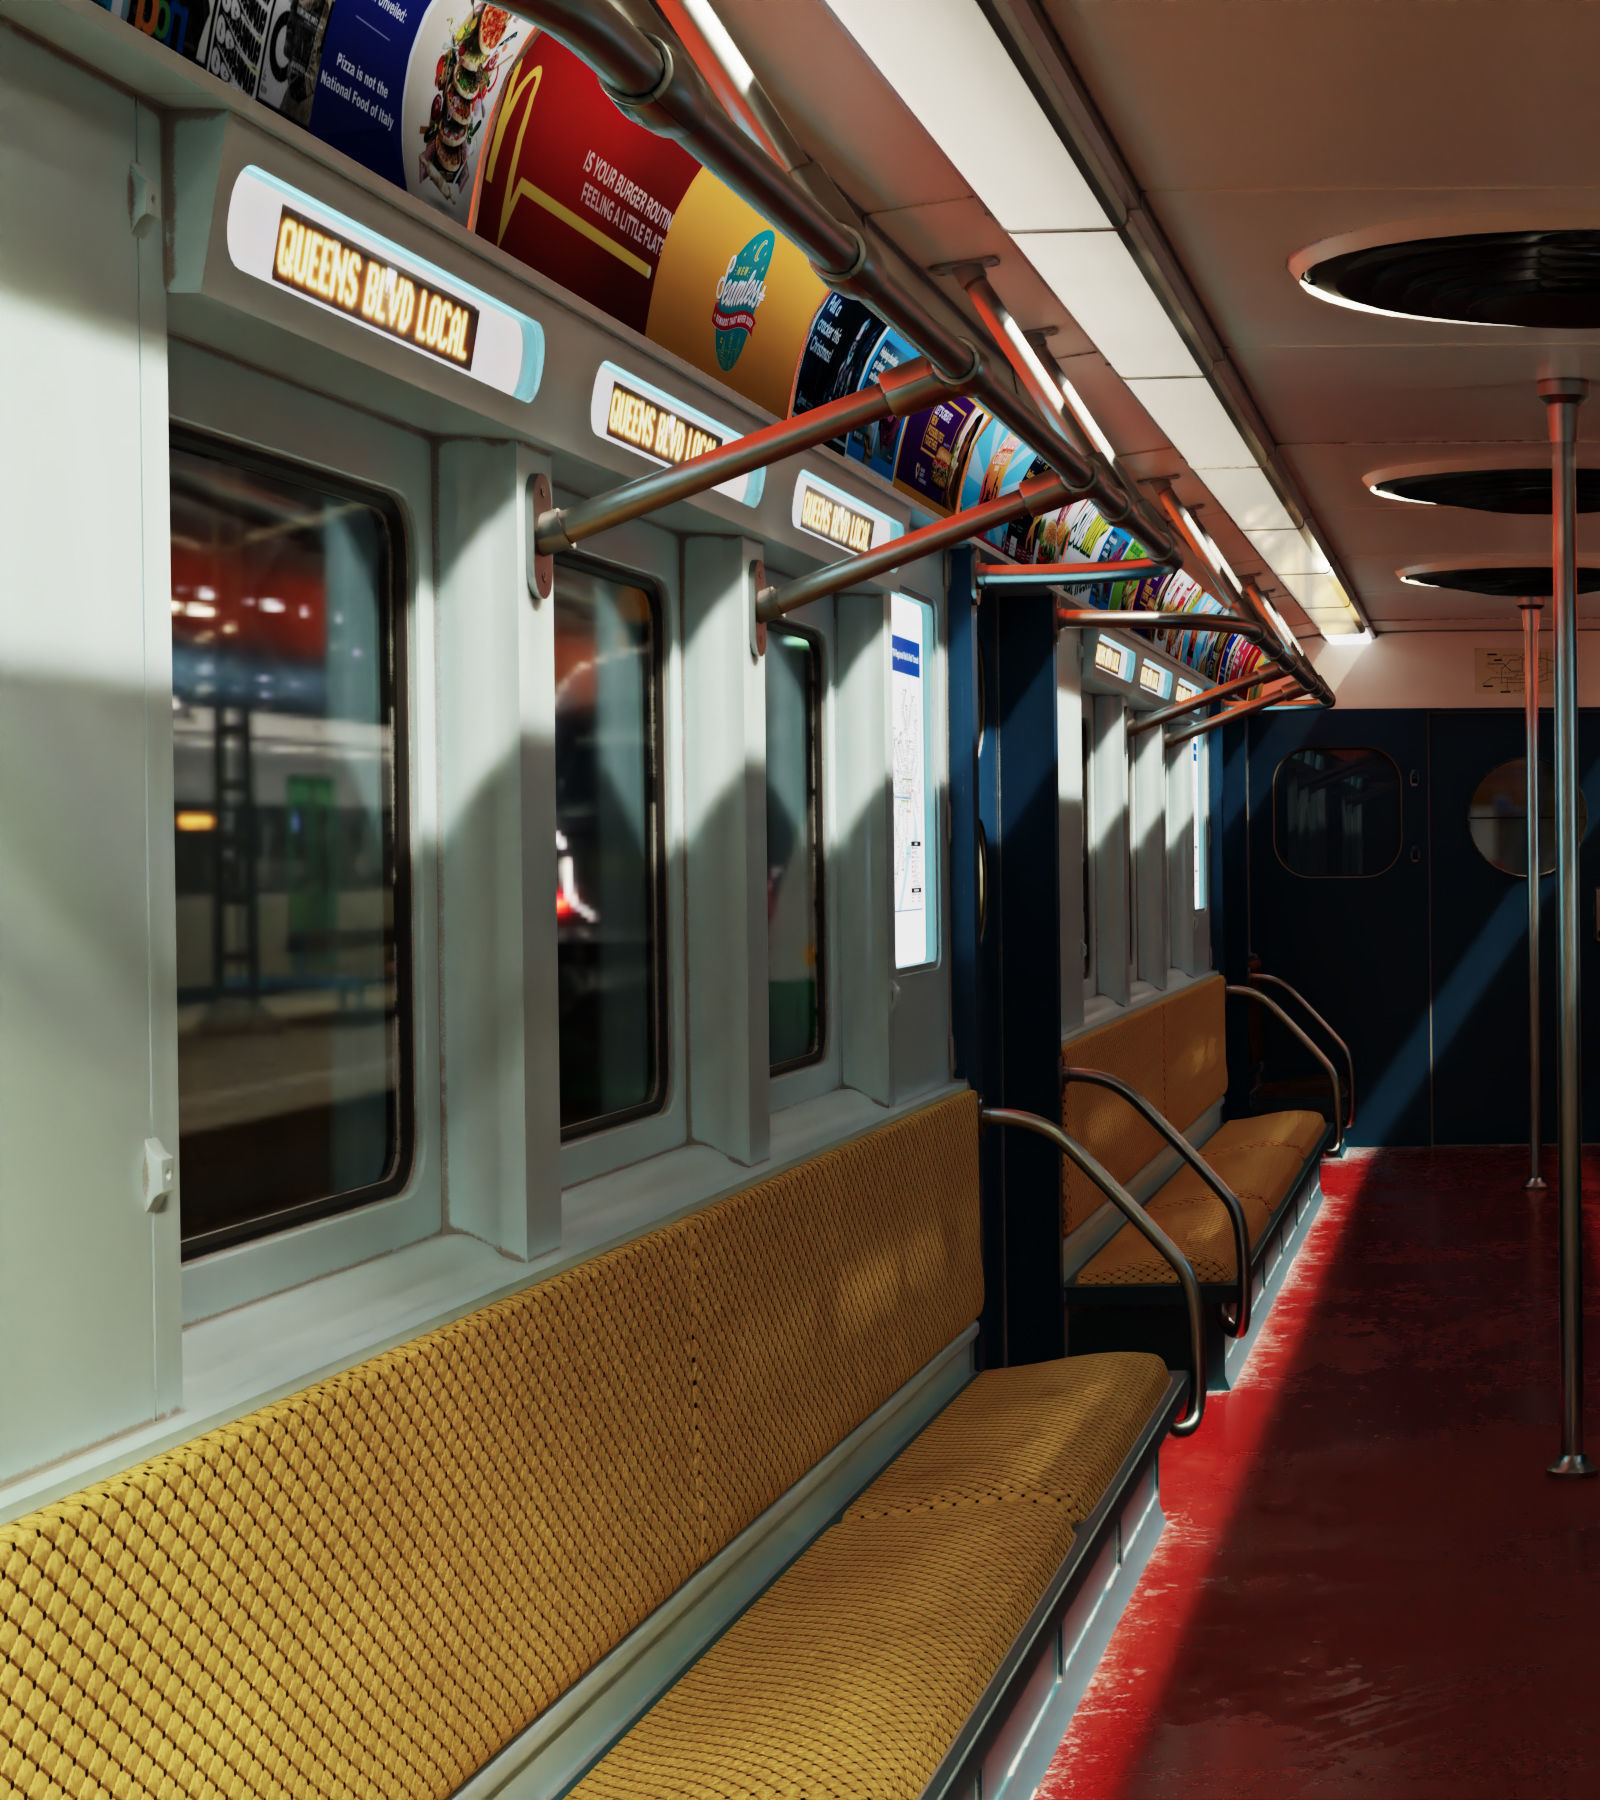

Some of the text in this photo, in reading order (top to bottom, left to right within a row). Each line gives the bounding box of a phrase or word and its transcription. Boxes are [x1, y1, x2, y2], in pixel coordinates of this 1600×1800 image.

[320, 69, 395, 132] National Food of Italy
[336, 51, 389, 99] Pizza is not the
[580, 181, 615, 222] FEELING
[612, 206, 621, 227] A
[619, 210, 645, 243] LITTLE
[582, 149, 674, 233] IS YOUR BURGER ROUTIN
[276, 217, 469, 362] QUEENS BLVD LOCAL
[609, 388, 656, 449] QUEENS
[654, 411, 686, 464] BLVD
[801, 490, 832, 536] QUEENS
